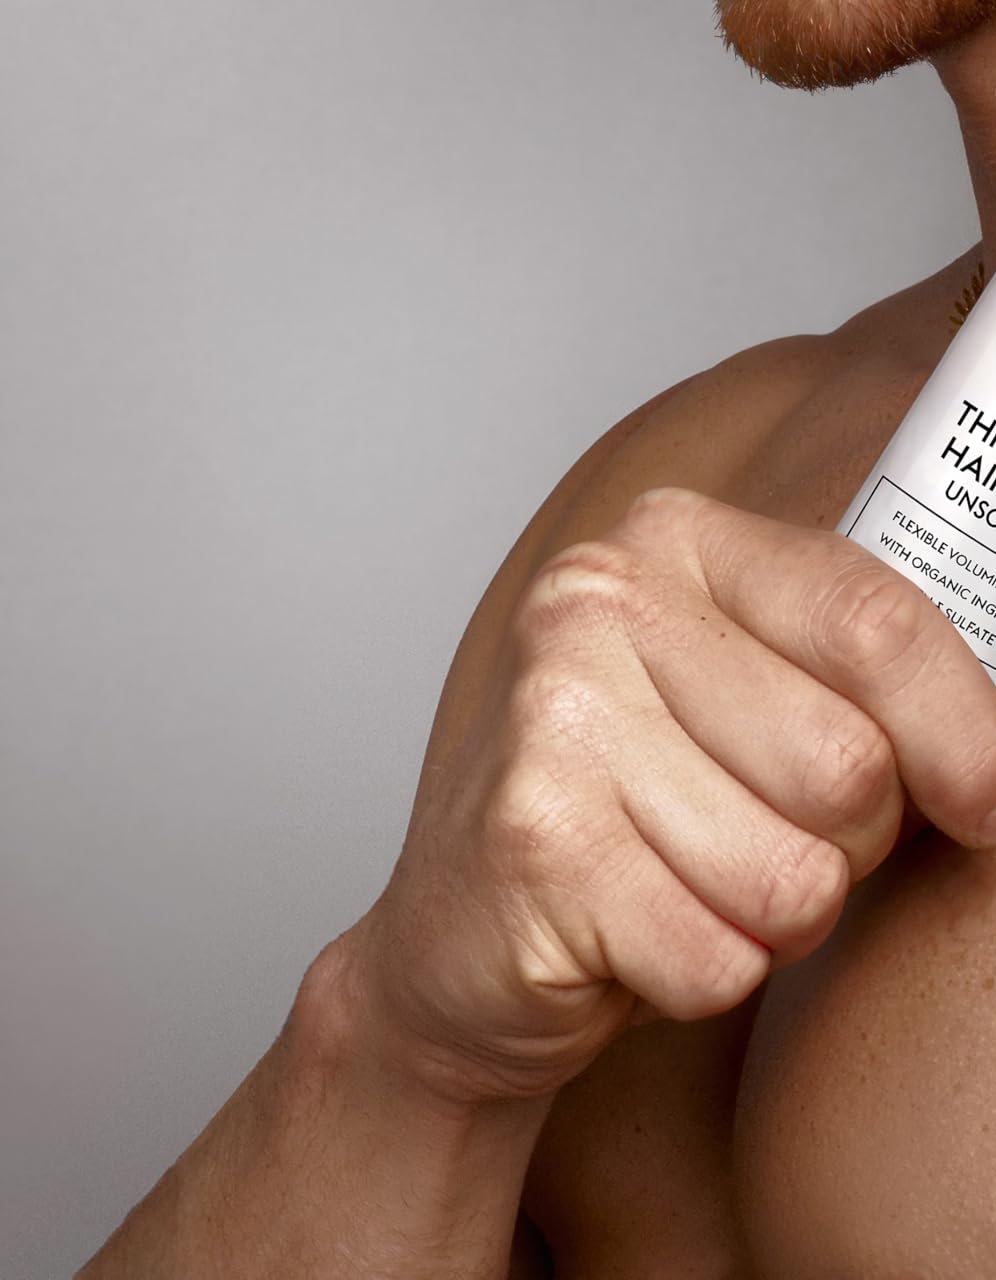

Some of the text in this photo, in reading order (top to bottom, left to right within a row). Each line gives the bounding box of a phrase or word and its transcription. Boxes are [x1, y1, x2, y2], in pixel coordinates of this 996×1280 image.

[892, 510, 949, 555] FLEXIBLE
[879, 531, 912, 562] WITH
[911, 556, 972, 600] ORGANIC
